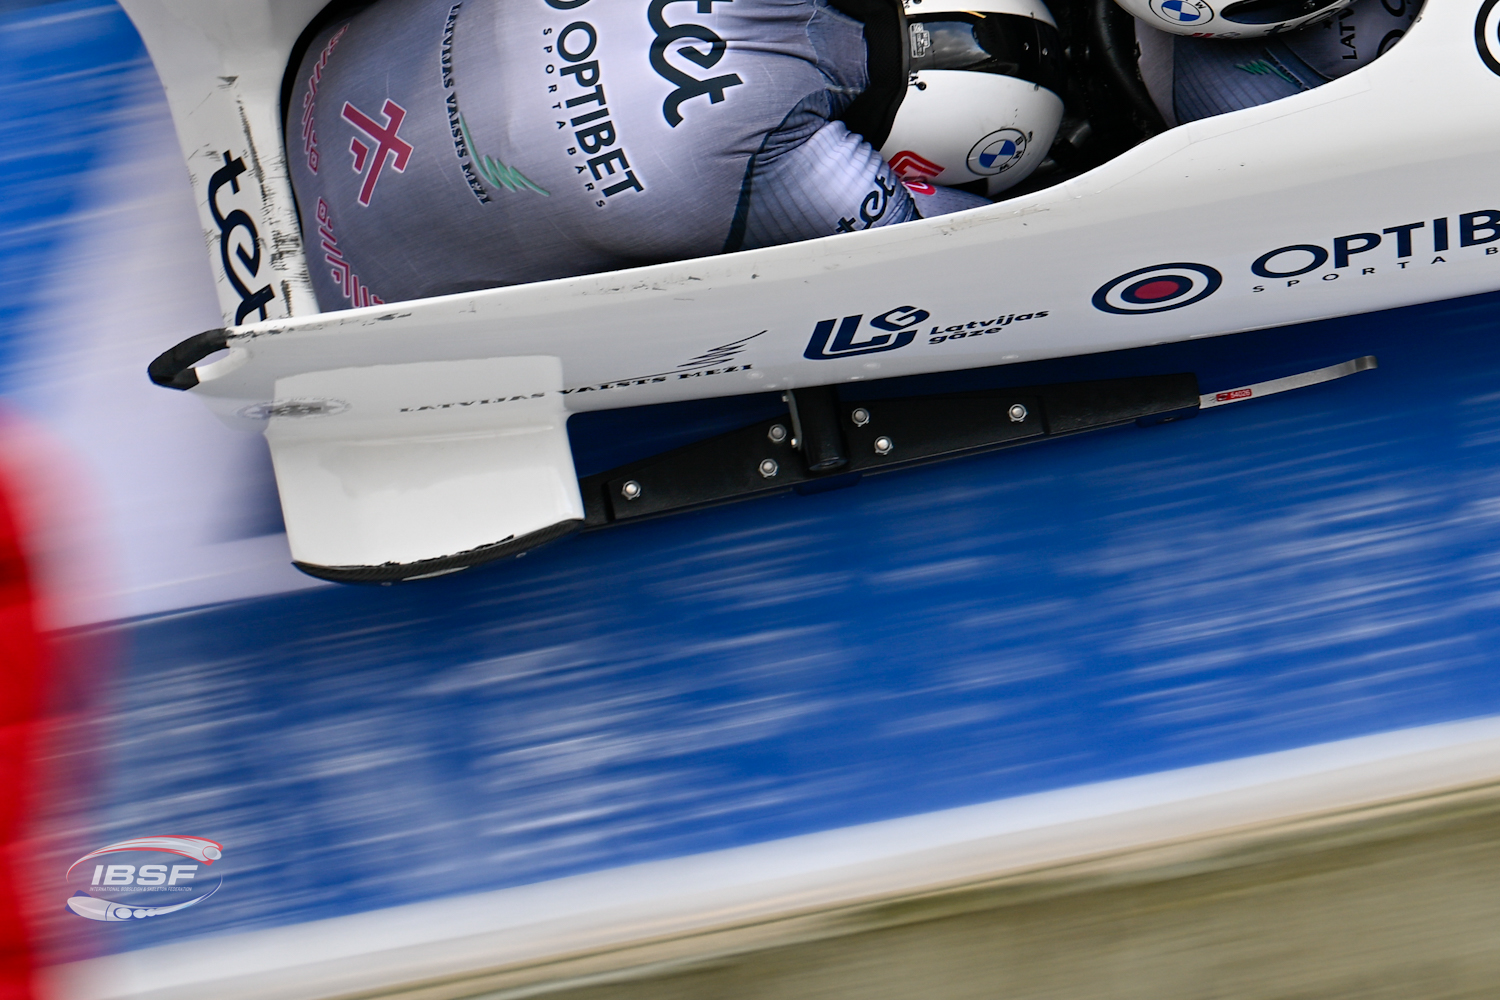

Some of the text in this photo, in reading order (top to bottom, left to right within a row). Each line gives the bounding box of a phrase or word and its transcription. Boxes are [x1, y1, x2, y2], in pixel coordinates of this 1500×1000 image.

[1338, 6, 1359, 61] LATV
[543, 27, 606, 209] SPORTA BĀRS
[556, 20, 645, 199] OPTIBET
[207, 149, 276, 327] tet
[1252, 255, 1447, 293] SPORTA
[929, 310, 1051, 336] Latvijas
[399, 392, 545, 413] LATVIJAS
[557, 376, 668, 395] VALSTS
